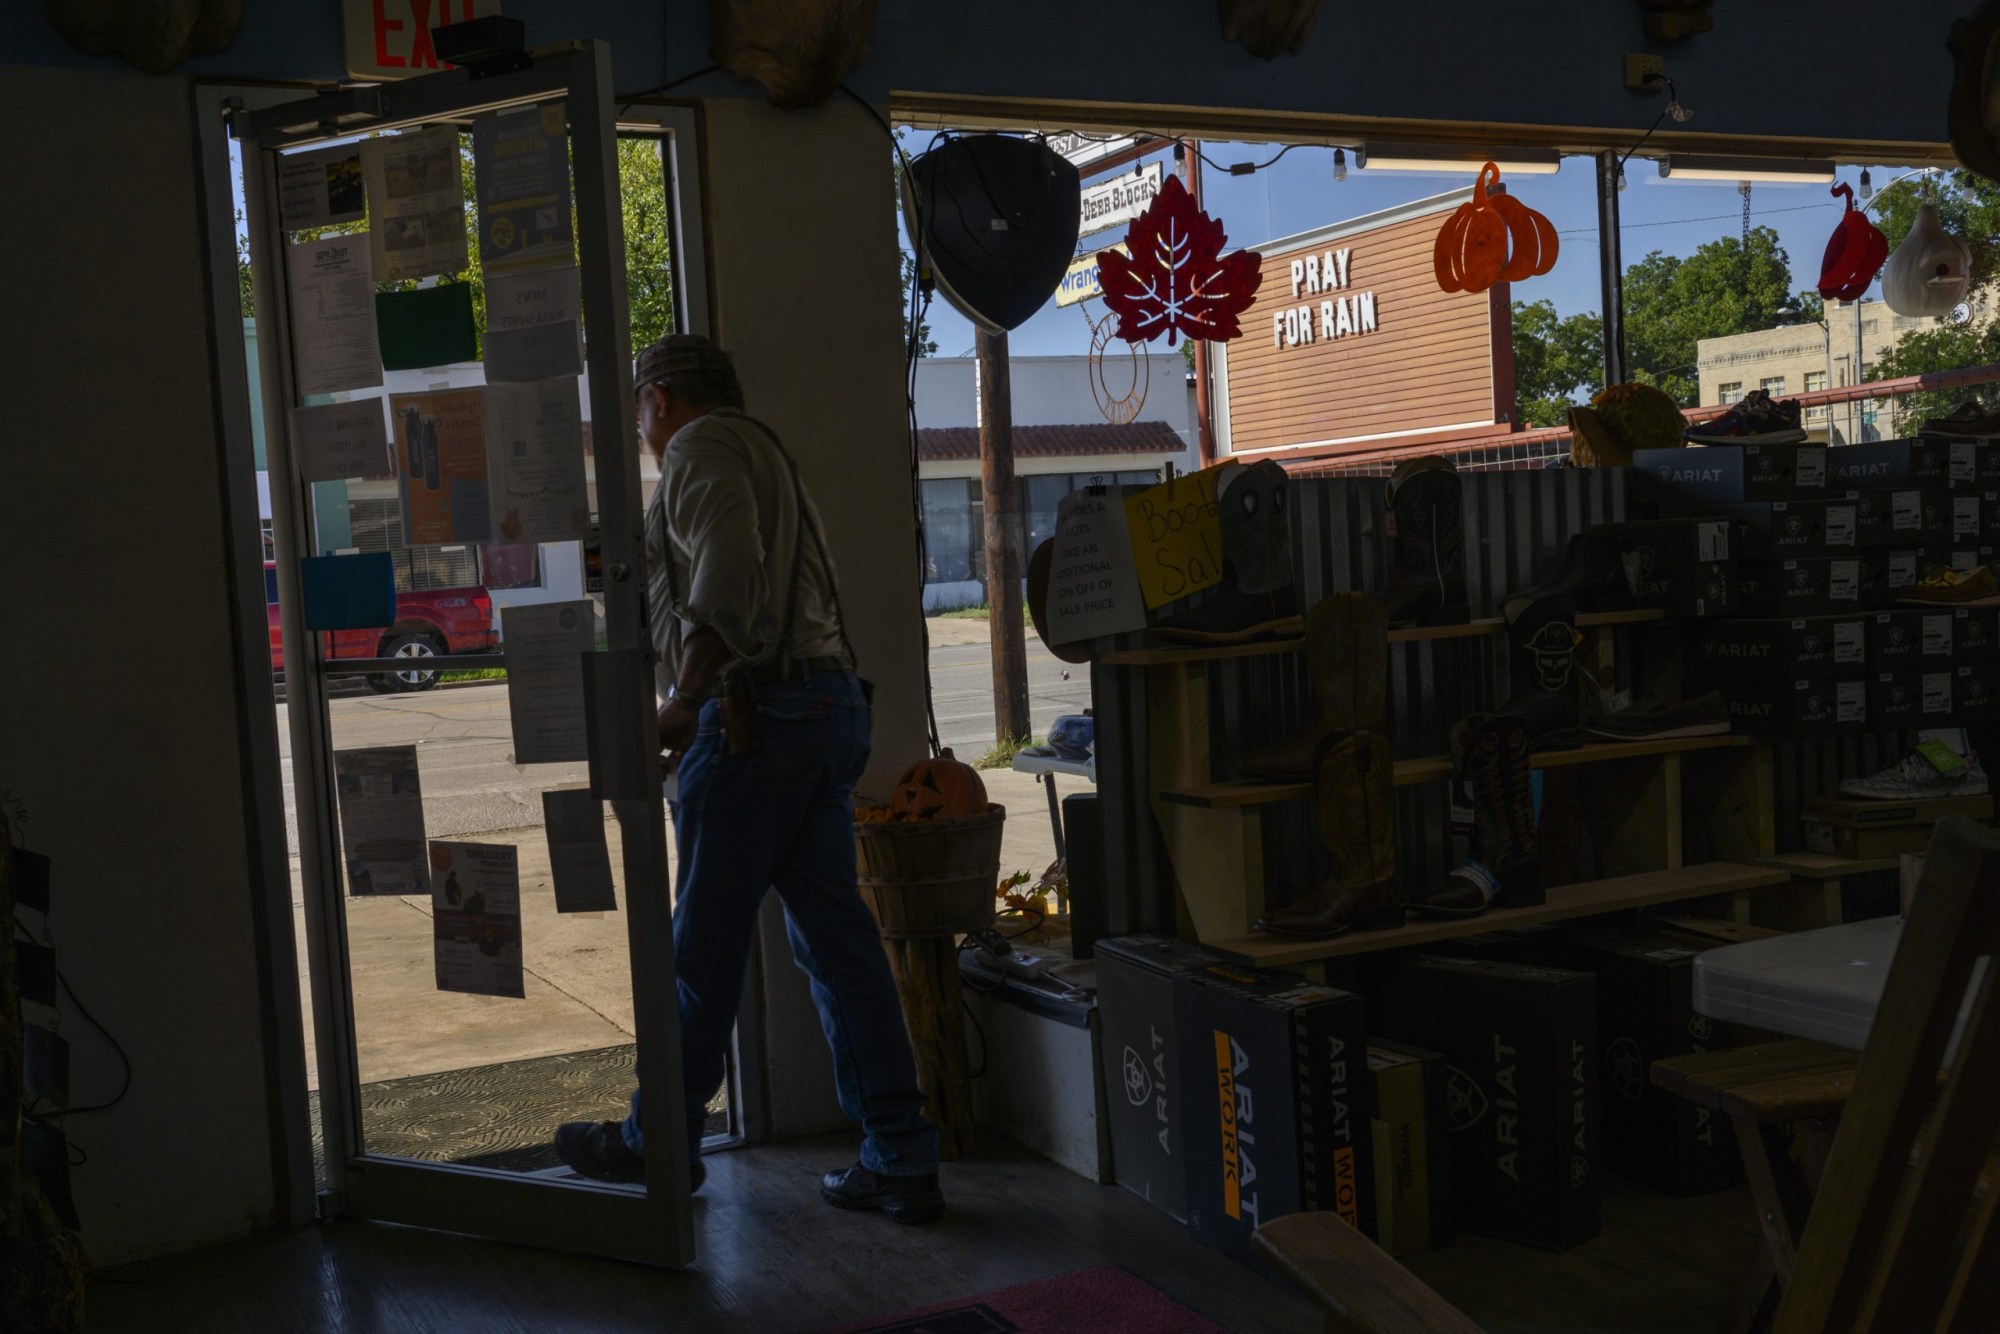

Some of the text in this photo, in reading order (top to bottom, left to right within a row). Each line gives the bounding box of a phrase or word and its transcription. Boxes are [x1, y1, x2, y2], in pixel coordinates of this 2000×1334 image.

[1112, 173, 1157, 210] BLOCKS
[1061, 265, 1101, 293] Wrang
[1291, 247, 1351, 297] PRAY
[1273, 290, 1378, 348] FOR RAIN
[1672, 468, 1723, 482] ARIAT
[1751, 473, 1779, 482] ARIAT
[1836, 461, 1891, 478] ARIAT
[1096, 502, 1106, 512] &
[1135, 479, 1218, 542] Boot
[1777, 536, 1808, 545] ARIAT
[1062, 543, 1098, 559] AKE AN
[1155, 533, 1220, 596] Sal
[1075, 582, 1095, 595] OFF
[1098, 578, 1114, 591] OF
[1786, 587, 1816, 597] ARIAT
[1058, 597, 1115, 618] SALE PRICE
[1716, 644, 1771, 657] ARIAT
[1882, 646, 1910, 655] ARIAT
[1960, 639, 1987, 649] ARIAT
[1797, 652, 1825, 662] ARIAT
[1729, 702, 1774, 716] RIAT
[1884, 704, 1912, 713] ARIAT
[1962, 697, 1989, 707] ARIAT
[1801, 712, 1827, 722] ARIAT
[1150, 1024, 1171, 1156] ARIAT
[1328, 1035, 1351, 1142] ARIAT
[1571, 1038, 1585, 1151] ARIAT
[1492, 1033, 1520, 1185] ARIAT
[1218, 1067, 1238, 1184] WORK
[1229, 1035, 1260, 1230] ARIAT
